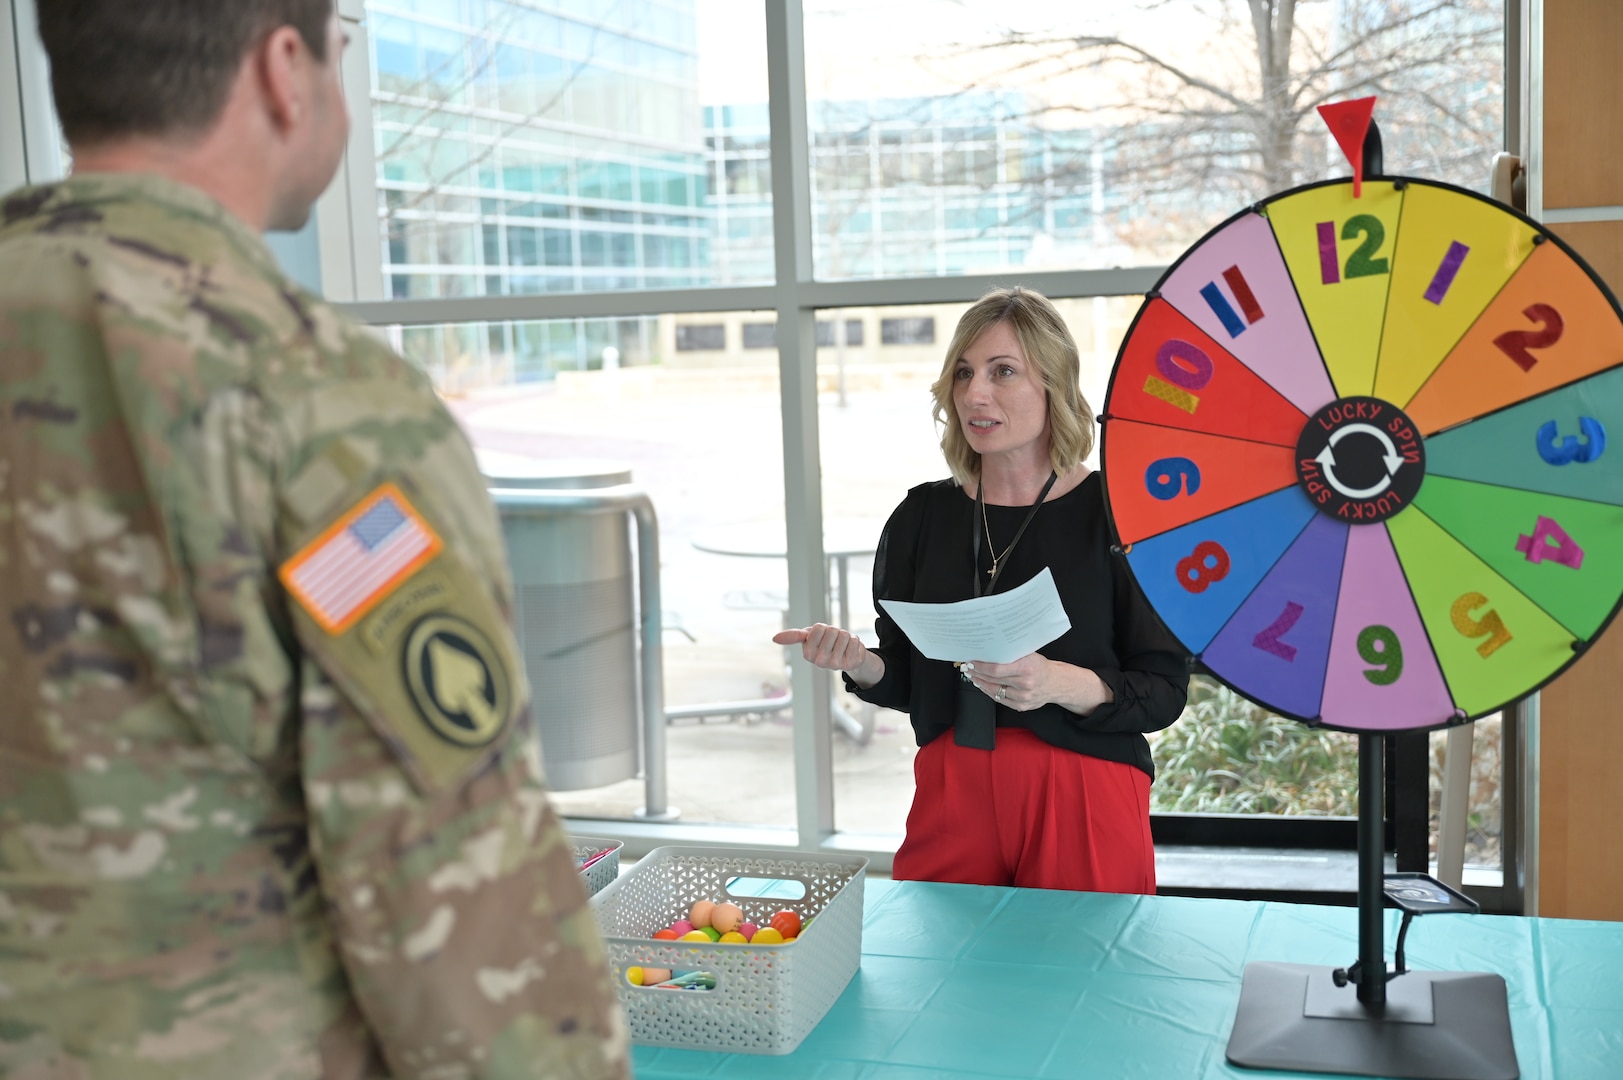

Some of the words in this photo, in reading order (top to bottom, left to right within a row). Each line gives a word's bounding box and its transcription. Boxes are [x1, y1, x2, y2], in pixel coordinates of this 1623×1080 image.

[1316, 213, 1389, 285] 12
[1423, 240, 1470, 306] 1
[1199, 264, 1265, 339] 11
[1492, 303, 1565, 373] 2
[1142, 339, 1214, 415] 10
[1319, 402, 1383, 431] LUCKY
[1387, 417, 1420, 464] SPIN
[1536, 416, 1606, 466] 3
[1300, 458, 1332, 504] SPIN
[1337, 490, 1402, 519] LUCKY
[1175, 540, 1230, 594] 8
[1515, 515, 1585, 570] 4
[1252, 600, 1305, 663] 7
[1449, 591, 1514, 660] 5
